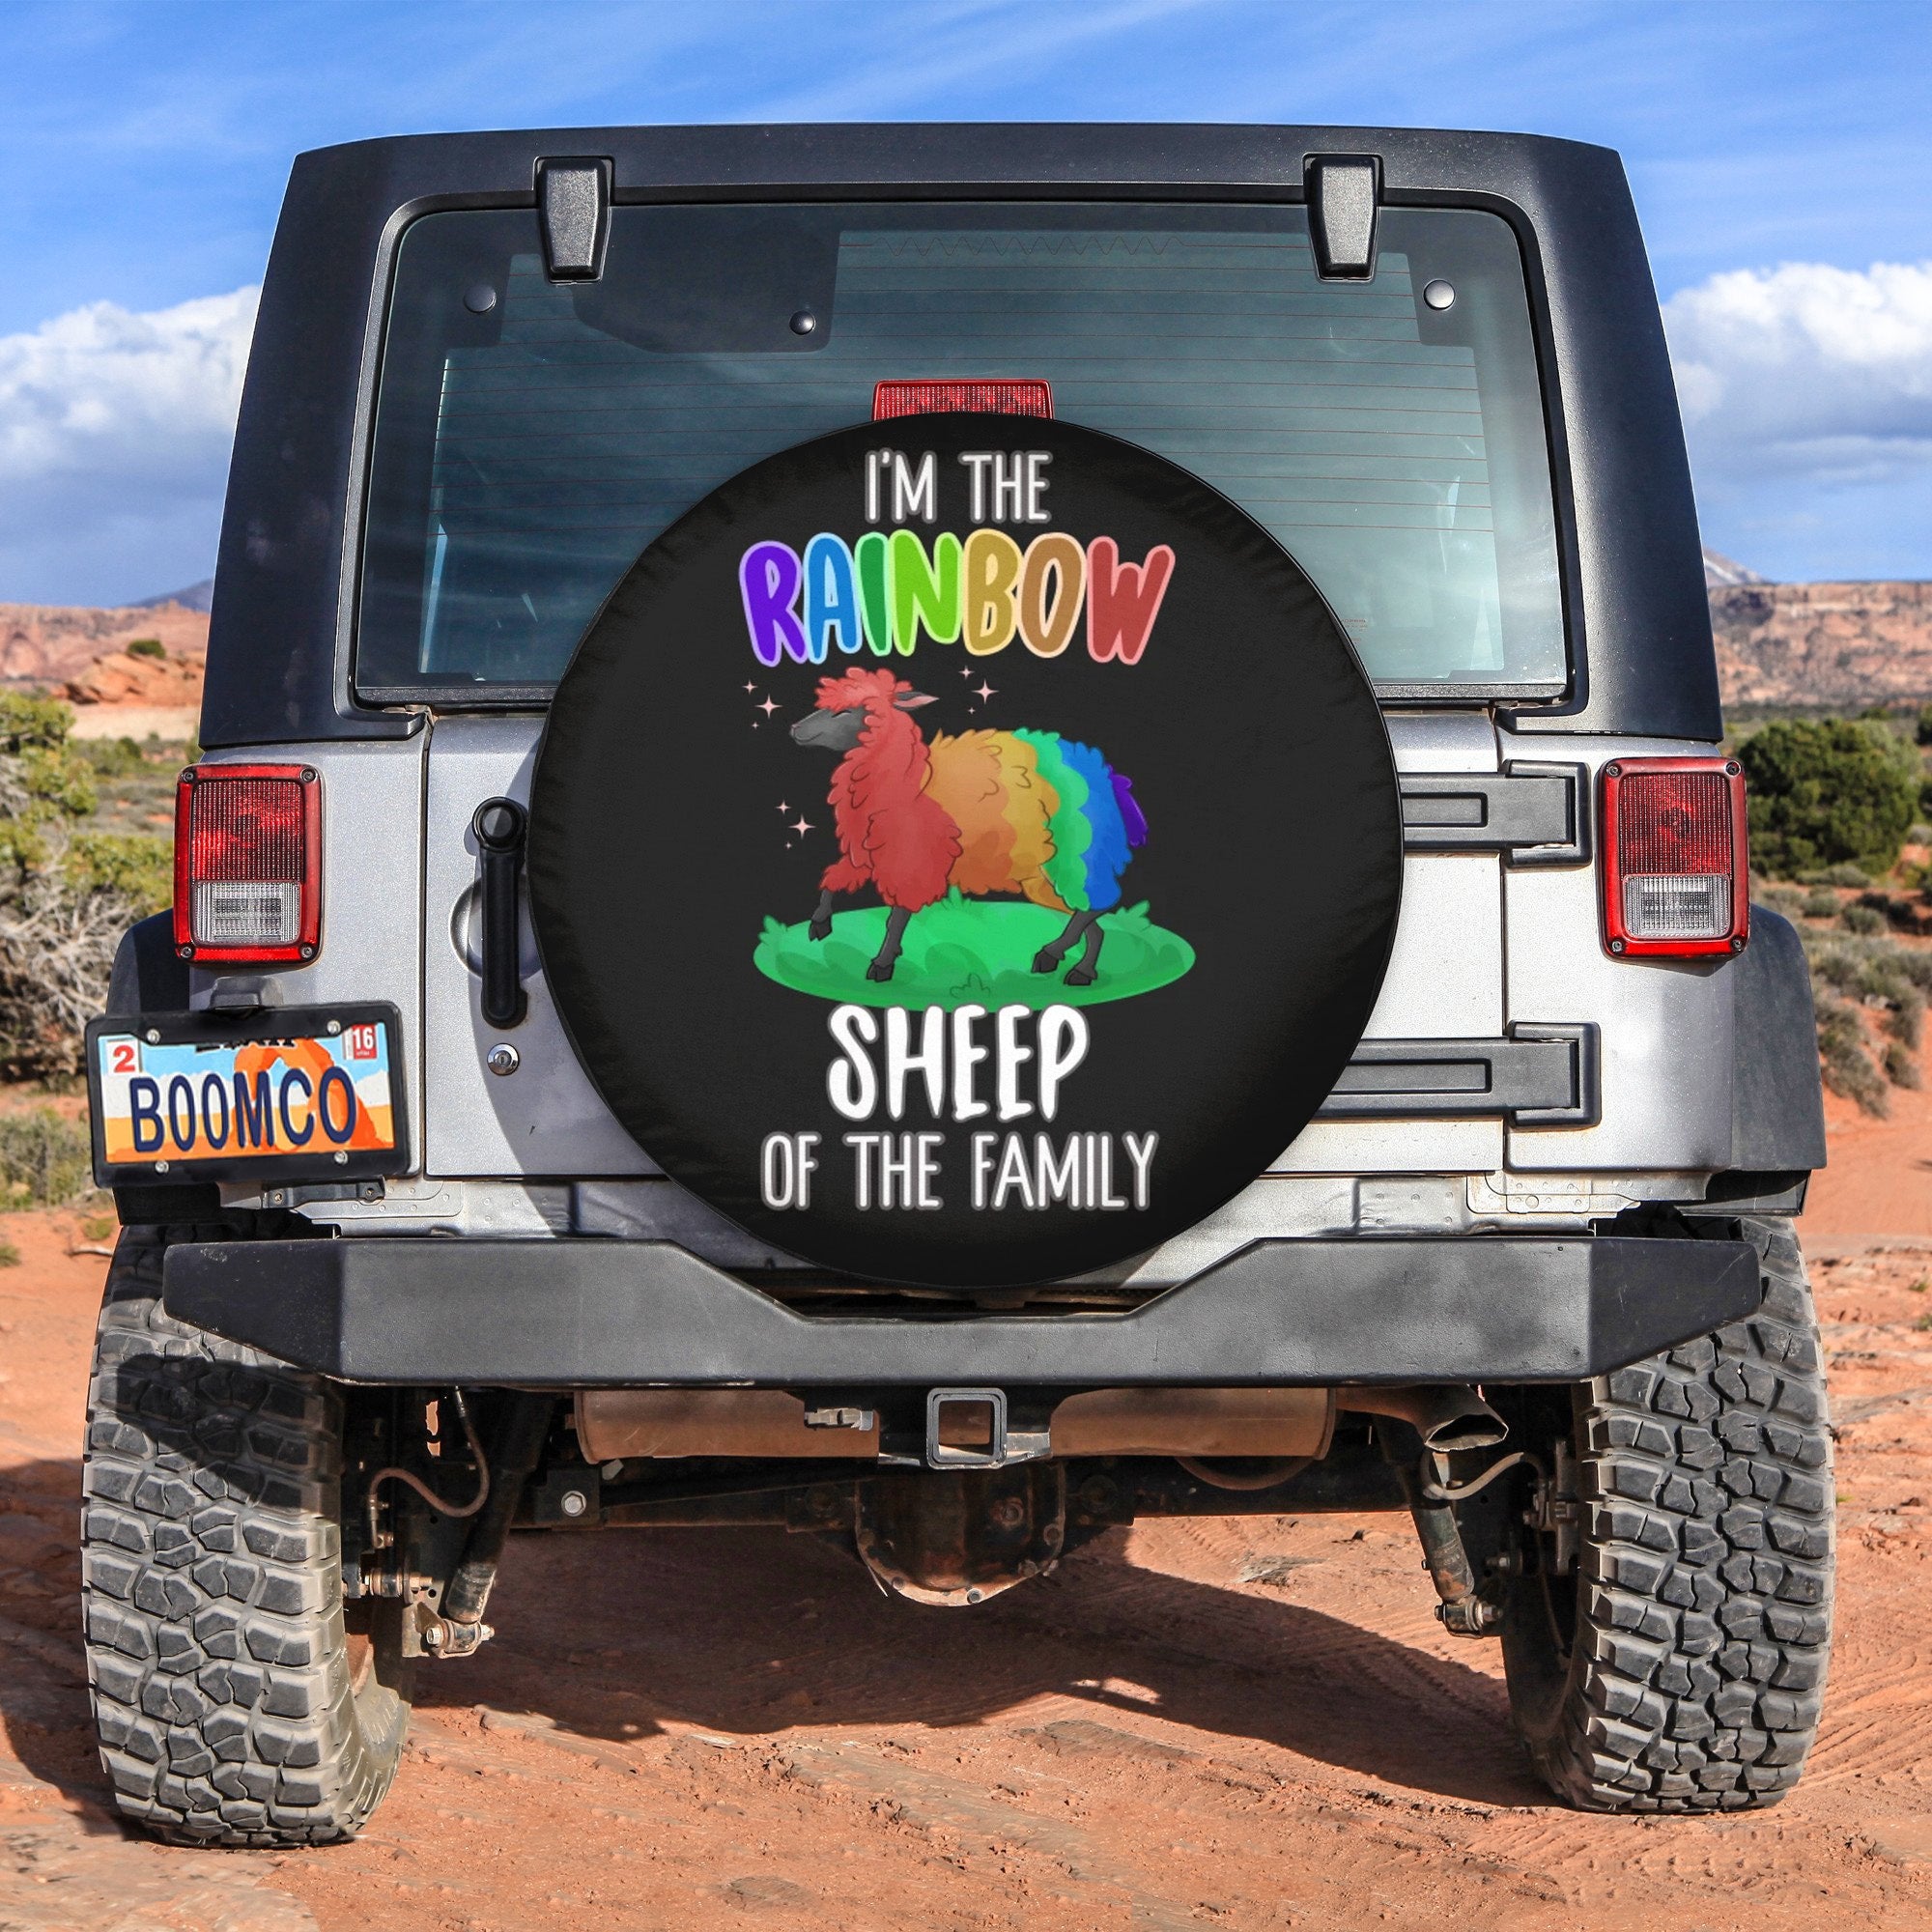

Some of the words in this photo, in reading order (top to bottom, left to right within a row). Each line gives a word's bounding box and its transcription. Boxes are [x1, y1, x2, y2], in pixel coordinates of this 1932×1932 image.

[866, 449, 936, 523] I'M
[959, 451, 1052, 523] THE
[739, 529, 1175, 666] RAINBOW
[113, 1045, 135, 1072] 2
[354, 1027, 374, 1050] 16
[827, 1004, 1090, 1122] SHEEP
[761, 1132, 821, 1210] OF
[842, 1132, 945, 1210] THE
[970, 1132, 1158, 1210] FAMILY
